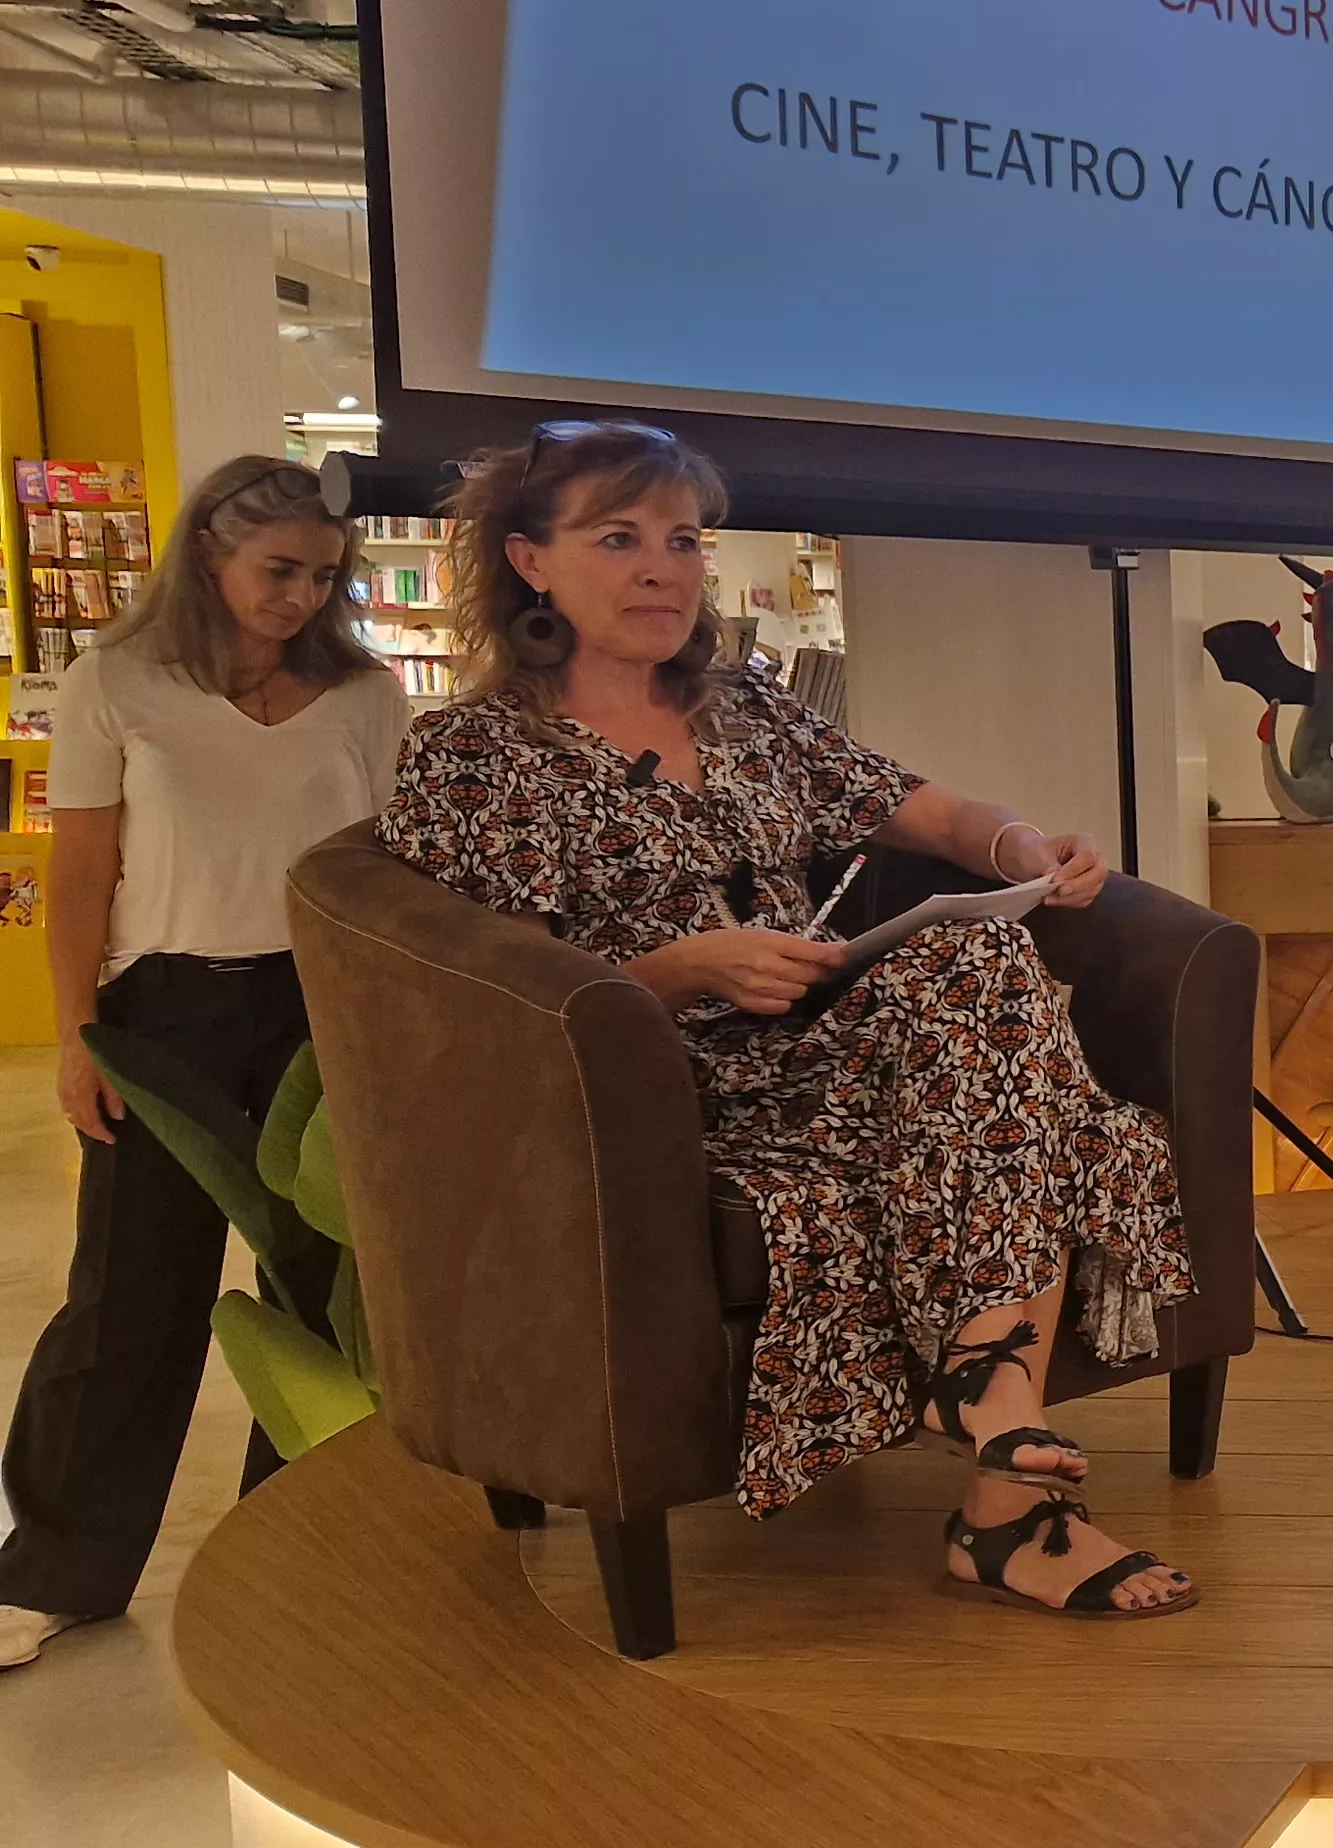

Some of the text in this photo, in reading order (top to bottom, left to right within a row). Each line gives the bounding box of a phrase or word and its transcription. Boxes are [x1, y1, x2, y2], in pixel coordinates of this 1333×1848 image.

[731, 82, 900, 176] CINE,
[920, 112, 1145, 201] TEATRO
[1164, 154, 1194, 209] Y
